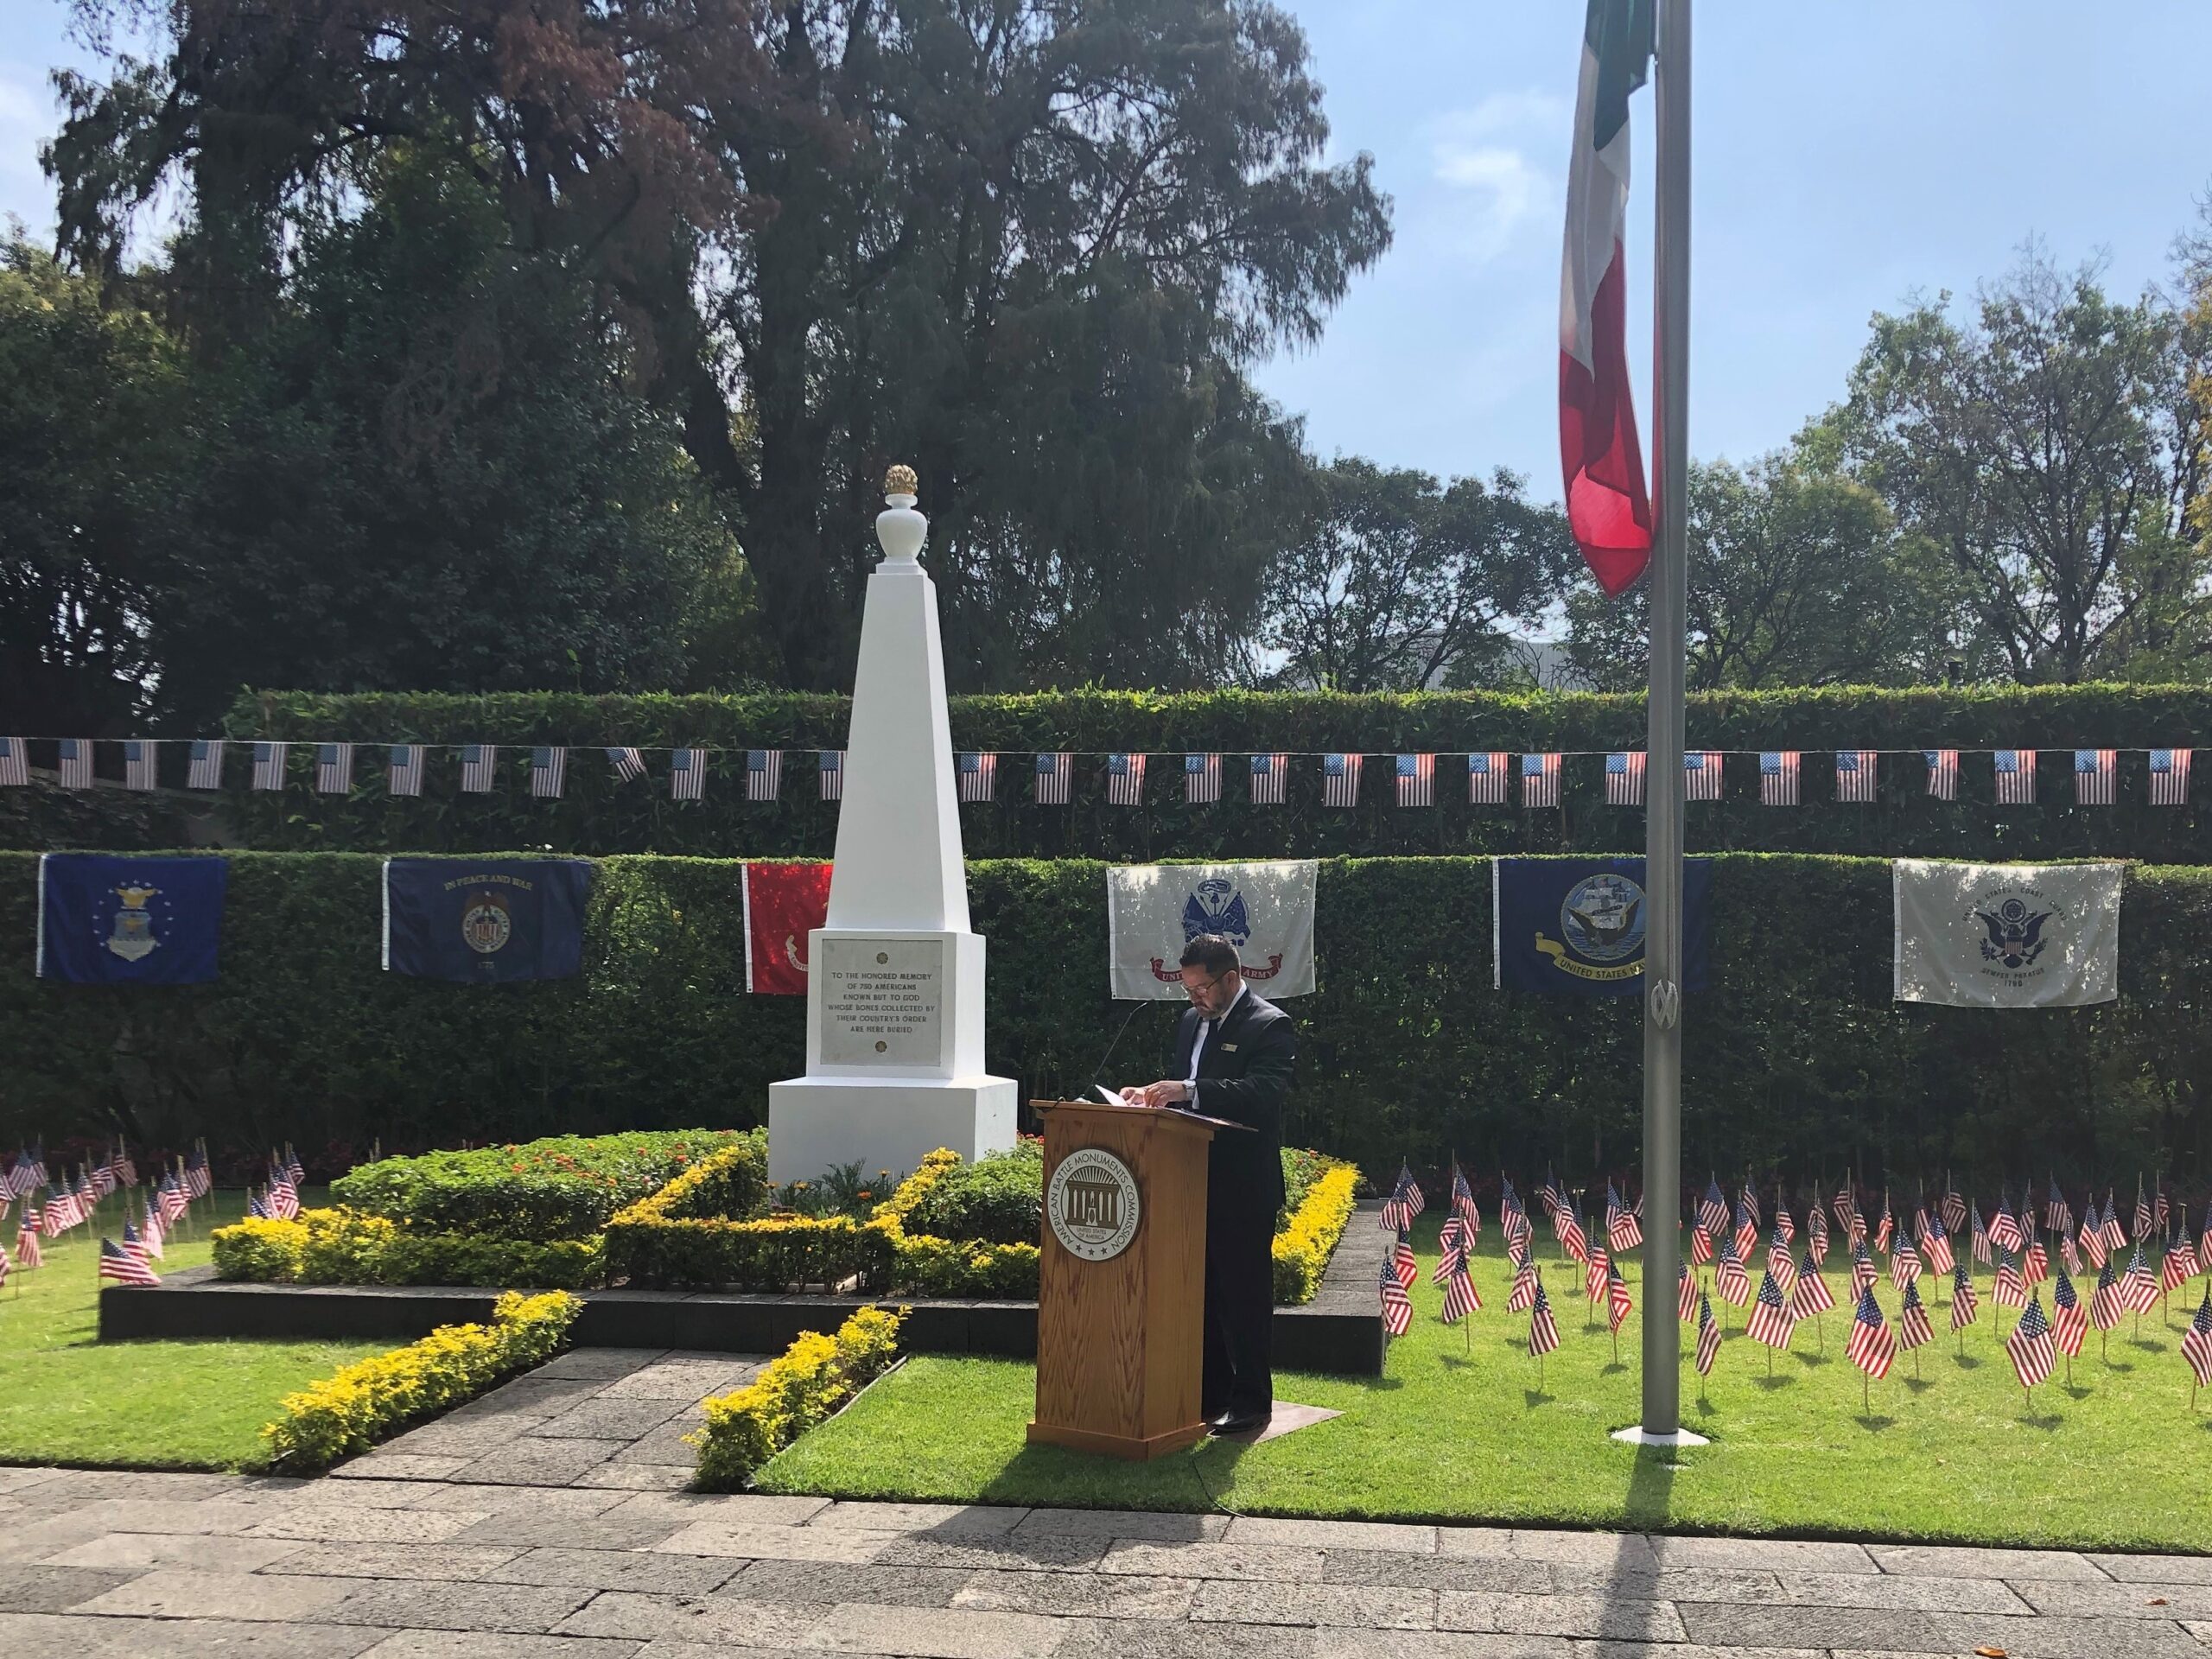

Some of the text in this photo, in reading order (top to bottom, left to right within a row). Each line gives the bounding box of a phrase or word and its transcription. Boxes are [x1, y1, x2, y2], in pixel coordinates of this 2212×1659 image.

[443, 874, 533, 891] IN PEACE AND WAR
[2020, 887, 2044, 899] COAST
[1243, 969, 1273, 978] ARMY
[1560, 959, 1592, 978] UNITED
[1596, 968, 1627, 979] STATES
[859, 1014, 900, 1023] COUNTRY'S
[902, 1014, 927, 1023] ORDER
[1051, 1153, 1136, 1251] AMERICAN BATTLE MONUMENTS COMMISSION
